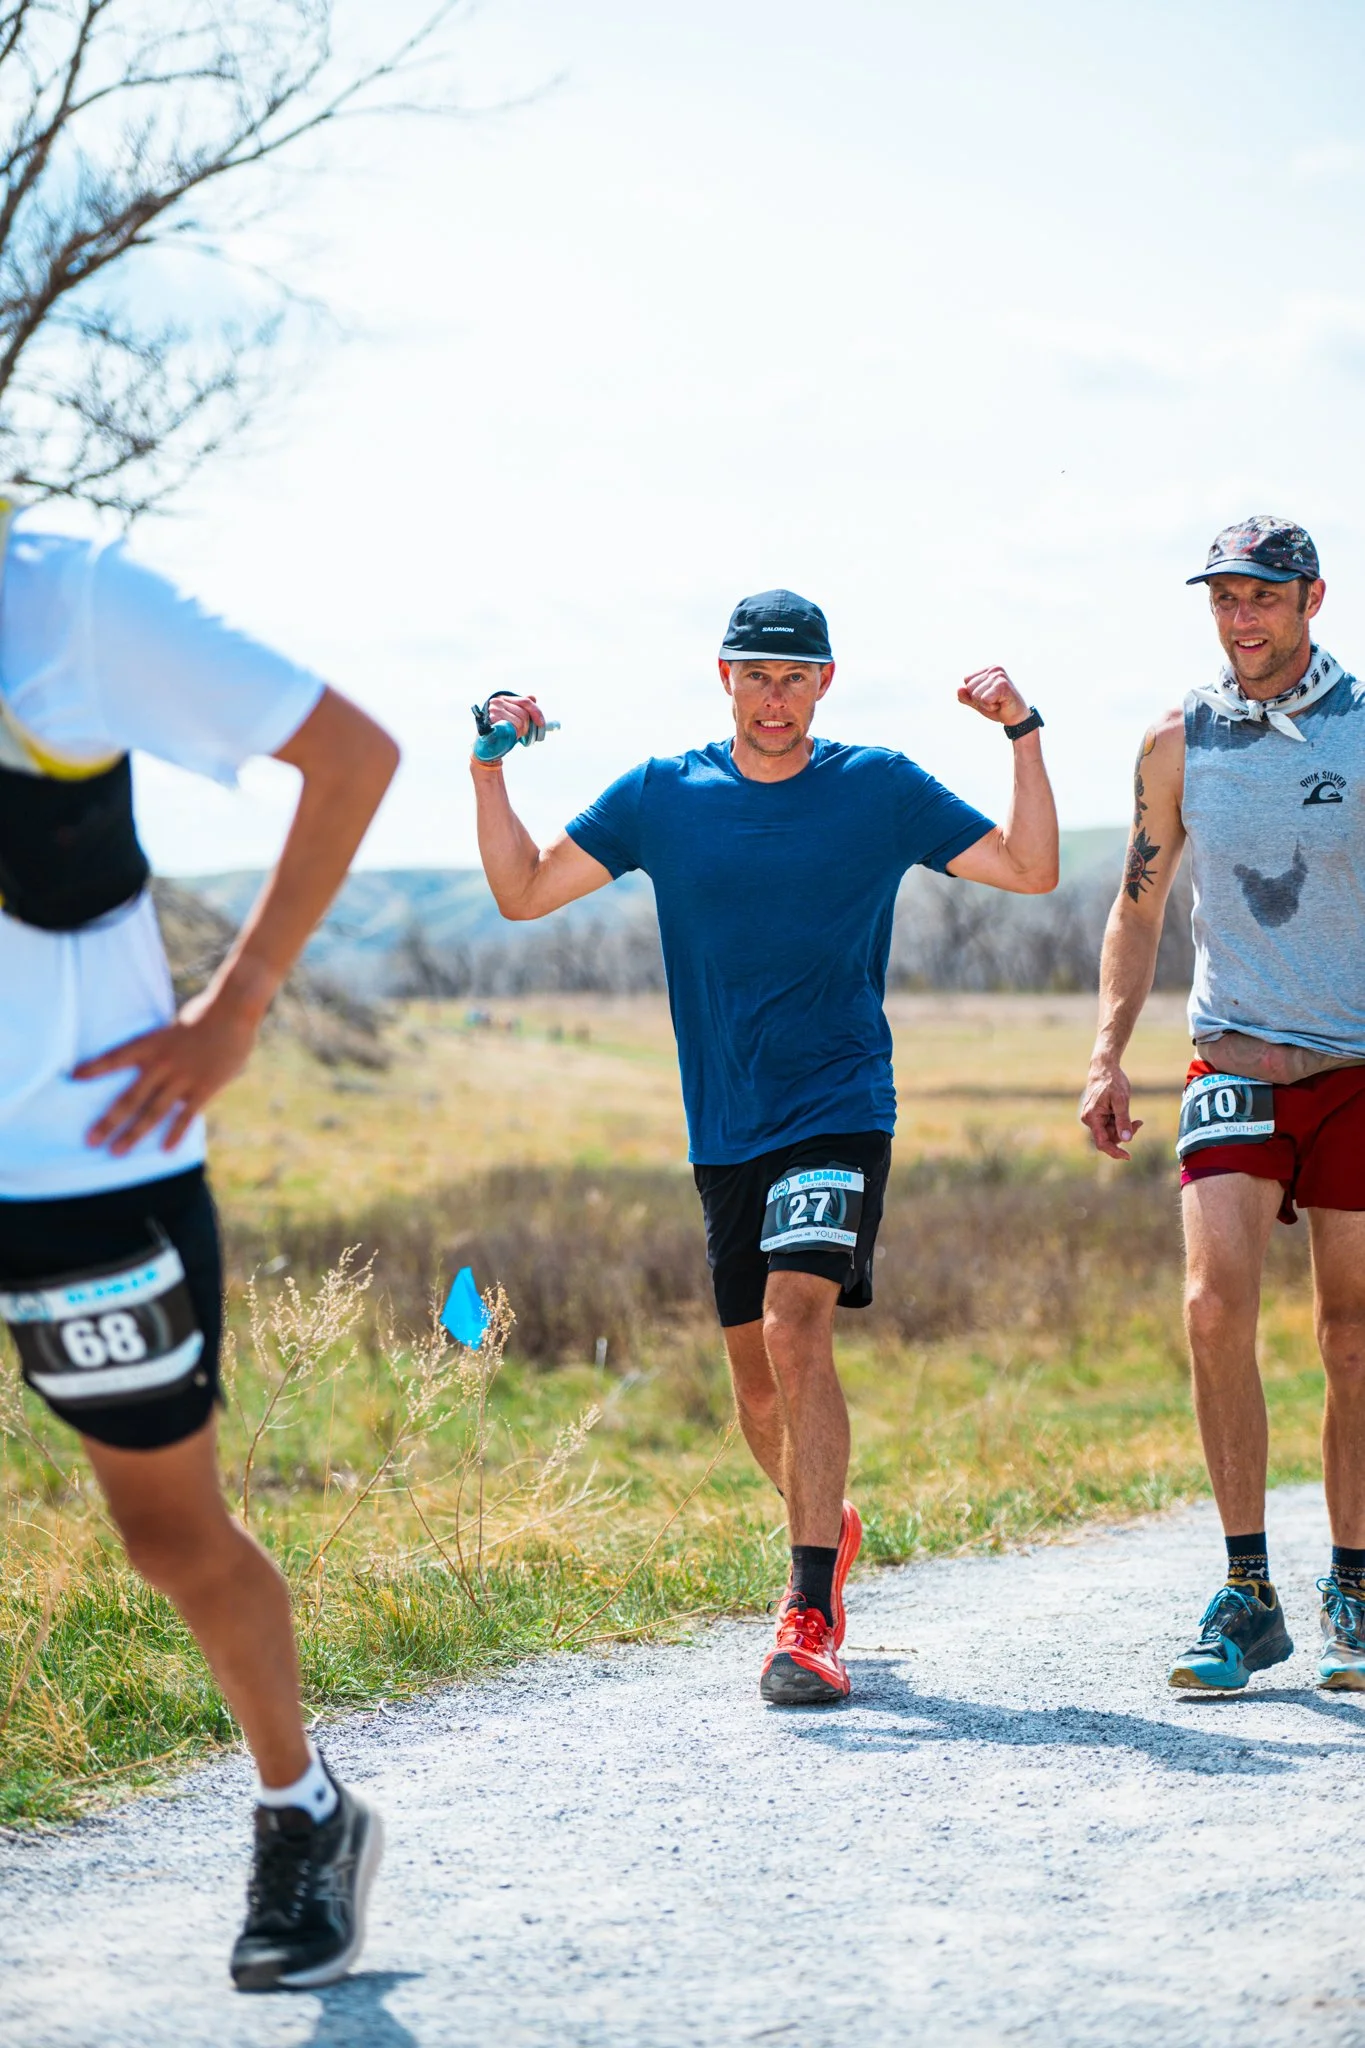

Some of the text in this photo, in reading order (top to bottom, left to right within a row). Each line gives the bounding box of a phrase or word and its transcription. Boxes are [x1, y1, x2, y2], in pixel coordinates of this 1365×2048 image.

[1300, 770, 1346, 789] QUIK SILVER
[1195, 1088, 1236, 1122] 10
[799, 1171, 852, 1184] OLDMAN
[801, 1181, 830, 1189] BACKYARD
[789, 1192, 830, 1225] 27
[61, 1310, 147, 1368] 68
